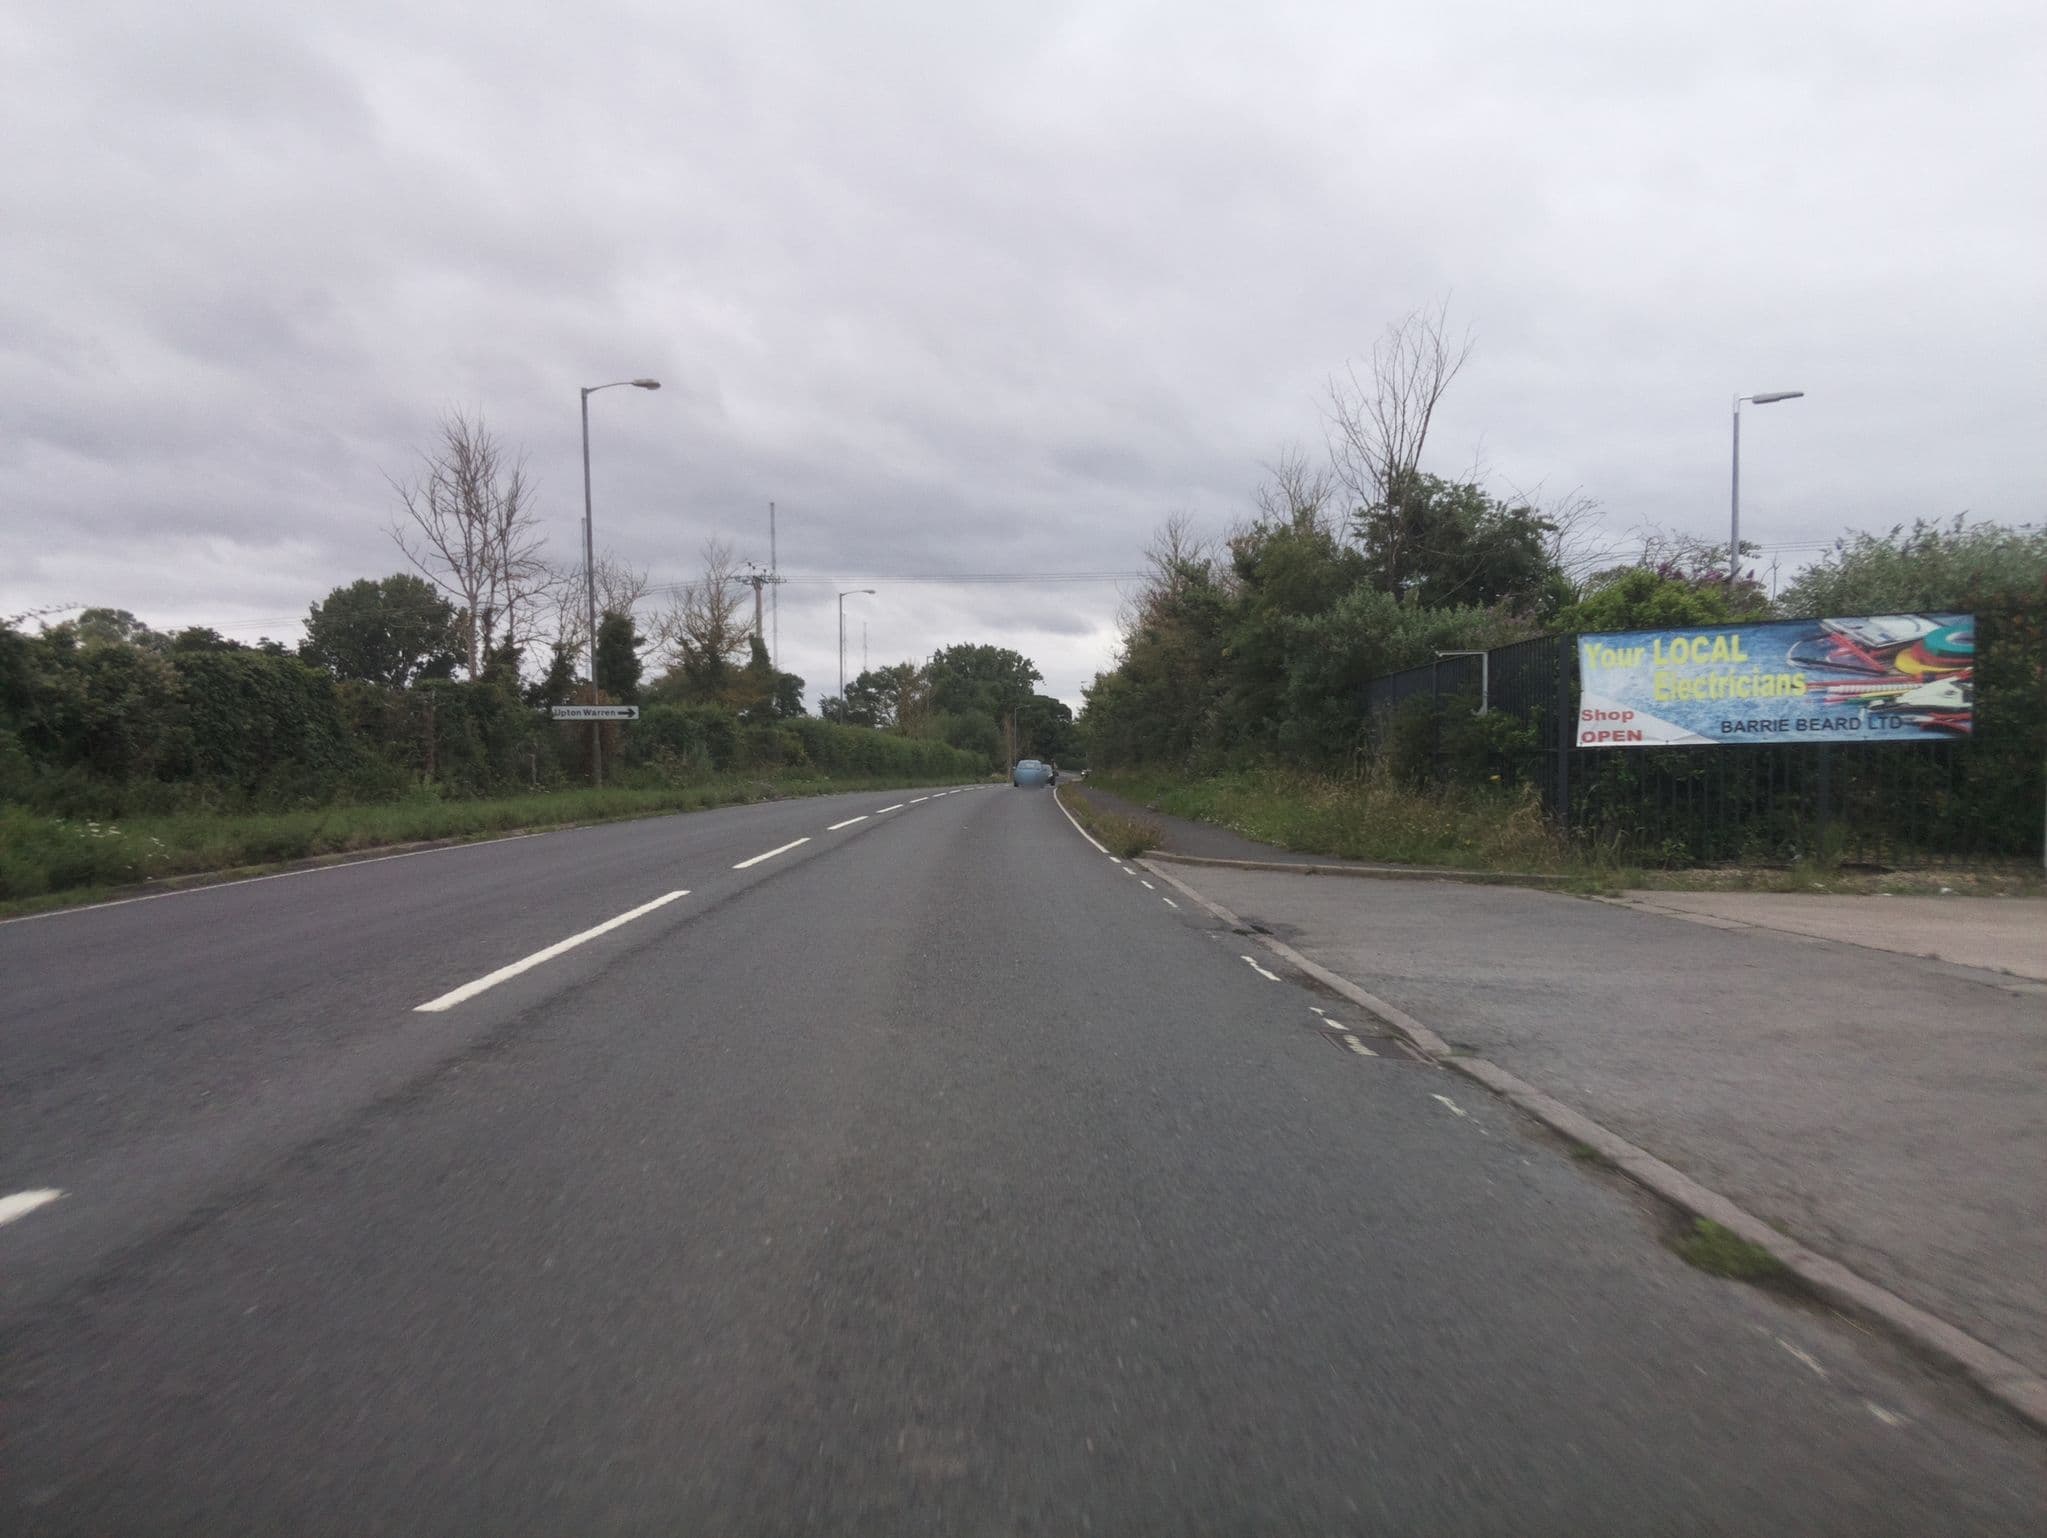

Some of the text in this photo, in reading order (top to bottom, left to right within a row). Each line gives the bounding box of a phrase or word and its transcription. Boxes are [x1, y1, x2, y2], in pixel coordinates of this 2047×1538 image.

[1586, 634, 1748, 671] Your LOCAL
[1654, 668, 1806, 701] Electricians
[1582, 709, 1634, 723] Shop
[1721, 715, 1902, 733] BARRIE BEARD LTD
[1582, 730, 1642, 743] OPEN
